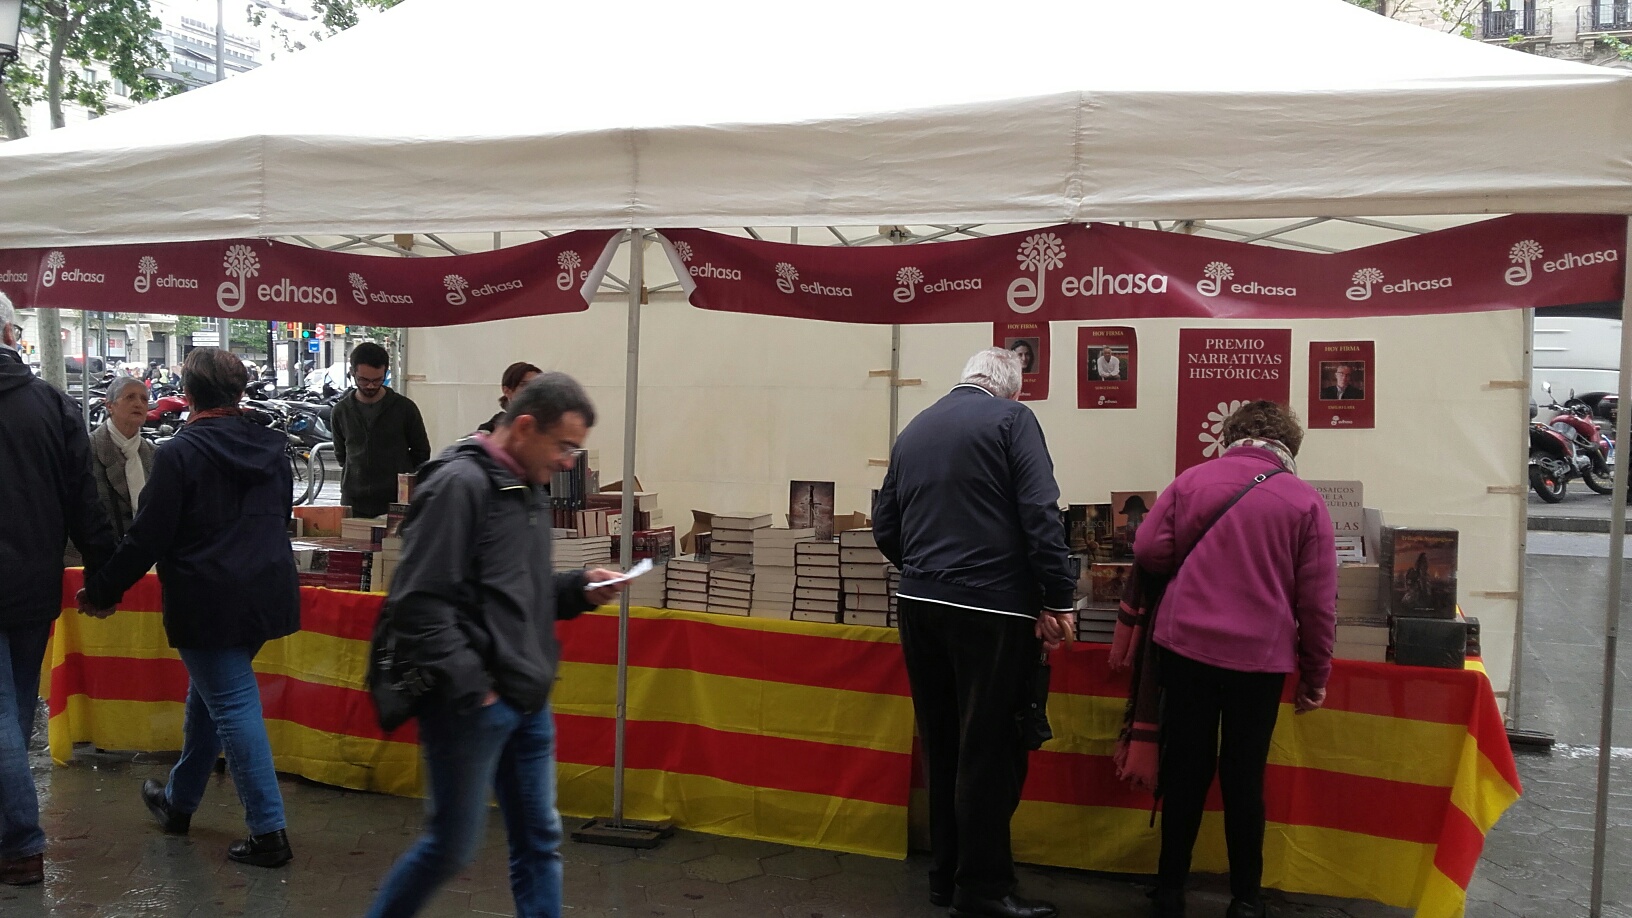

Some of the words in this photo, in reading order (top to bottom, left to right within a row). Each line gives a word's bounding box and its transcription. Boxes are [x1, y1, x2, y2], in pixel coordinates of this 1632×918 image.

[1542, 249, 1619, 274] edhasa
[61, 268, 105, 284] edhasa
[689, 262, 742, 281] edhasa
[156, 274, 199, 289] edhasa
[471, 277, 524, 298] edhasa
[799, 281, 853, 298] edhasa
[923, 278, 982, 294] edhasa
[1061, 266, 1168, 297] edhasa
[1230, 281, 1297, 297] edhasa
[1382, 275, 1453, 294] edhasa
[257, 277, 338, 306] edhasa
[370, 290, 414, 305] edhasa
[1205, 338, 1265, 350] PREMIO
[1188, 353, 1282, 365] NARRATIVAS
[1189, 366, 1280, 380] HISTÓRICAS
[1333, 521, 1360, 531] LAS
